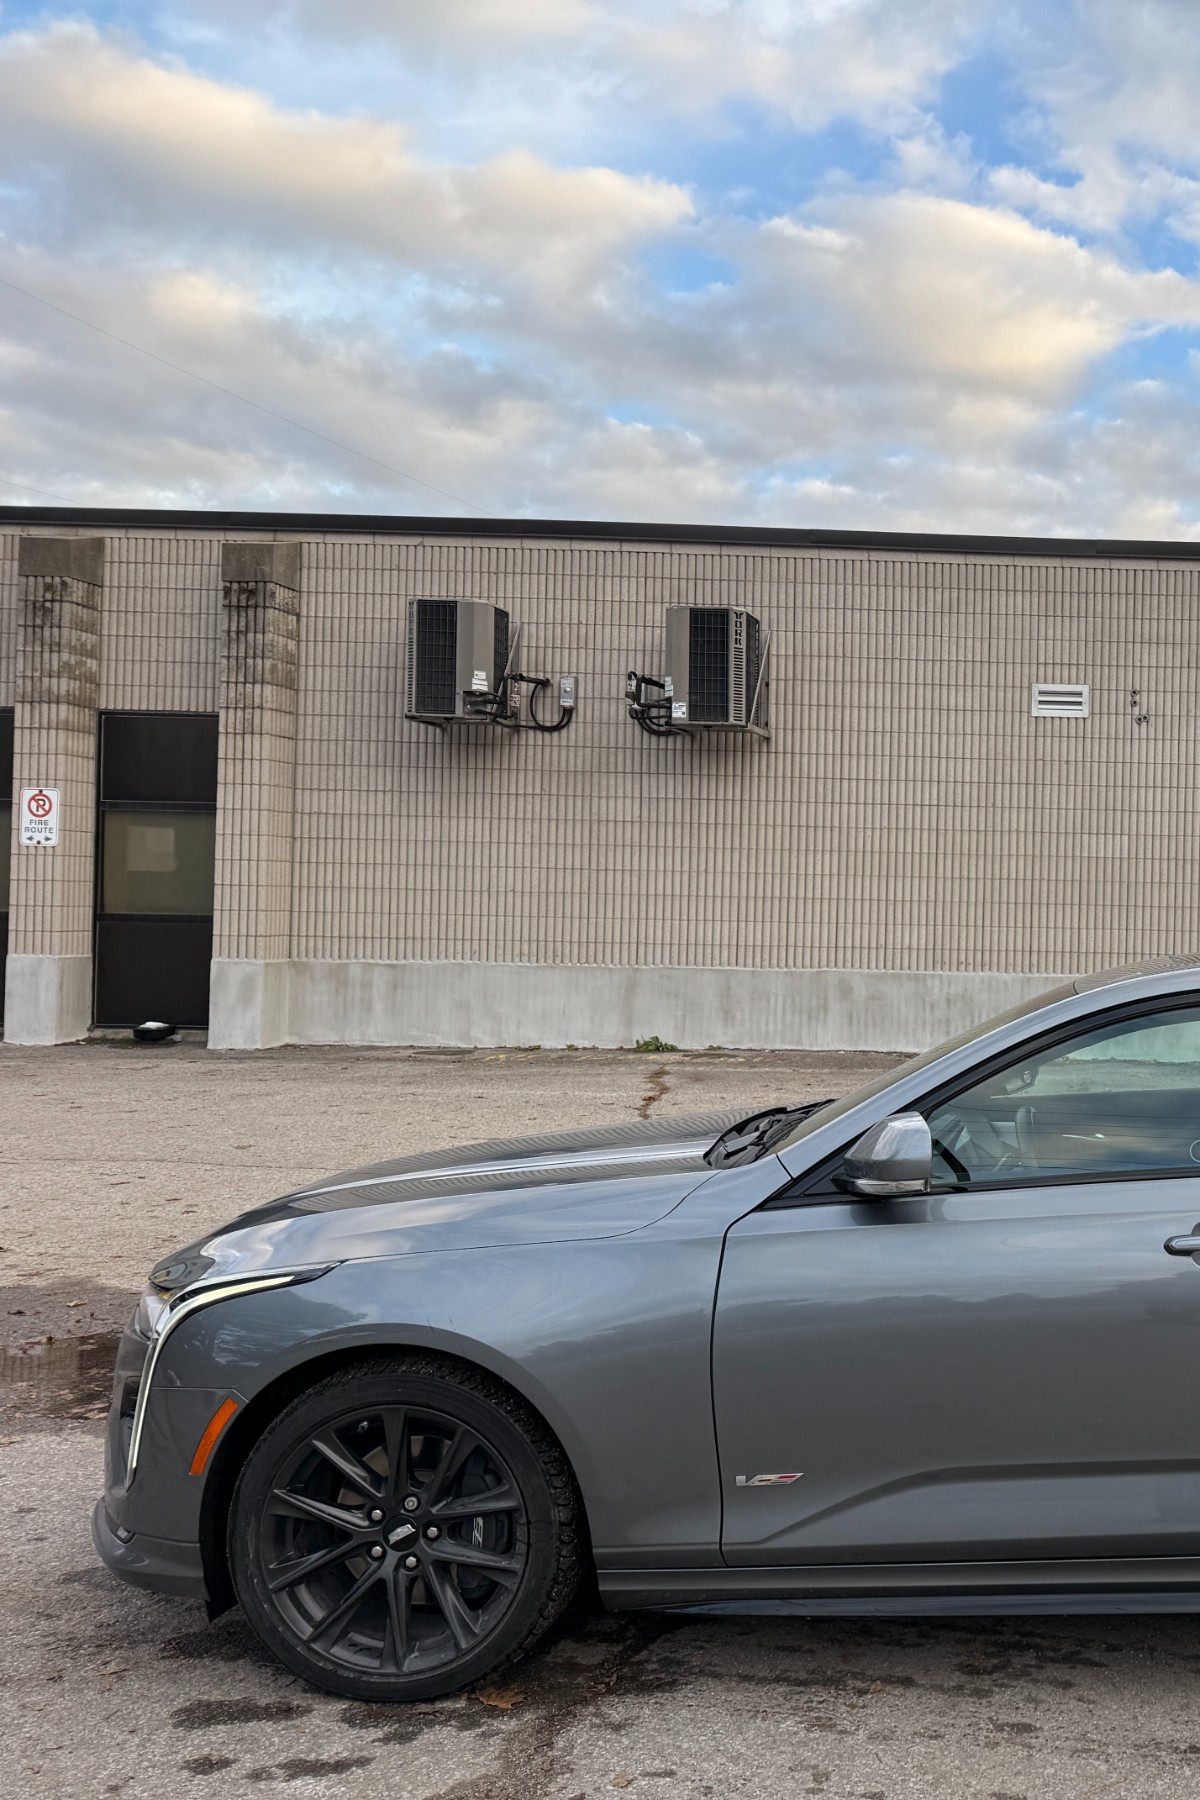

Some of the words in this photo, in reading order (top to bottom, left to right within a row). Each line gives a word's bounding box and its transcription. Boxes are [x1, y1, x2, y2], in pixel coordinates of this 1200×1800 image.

[733, 611, 744, 646] YORK
[29, 819, 49, 827] FIRE
[24, 826, 54, 834] ROUTE
